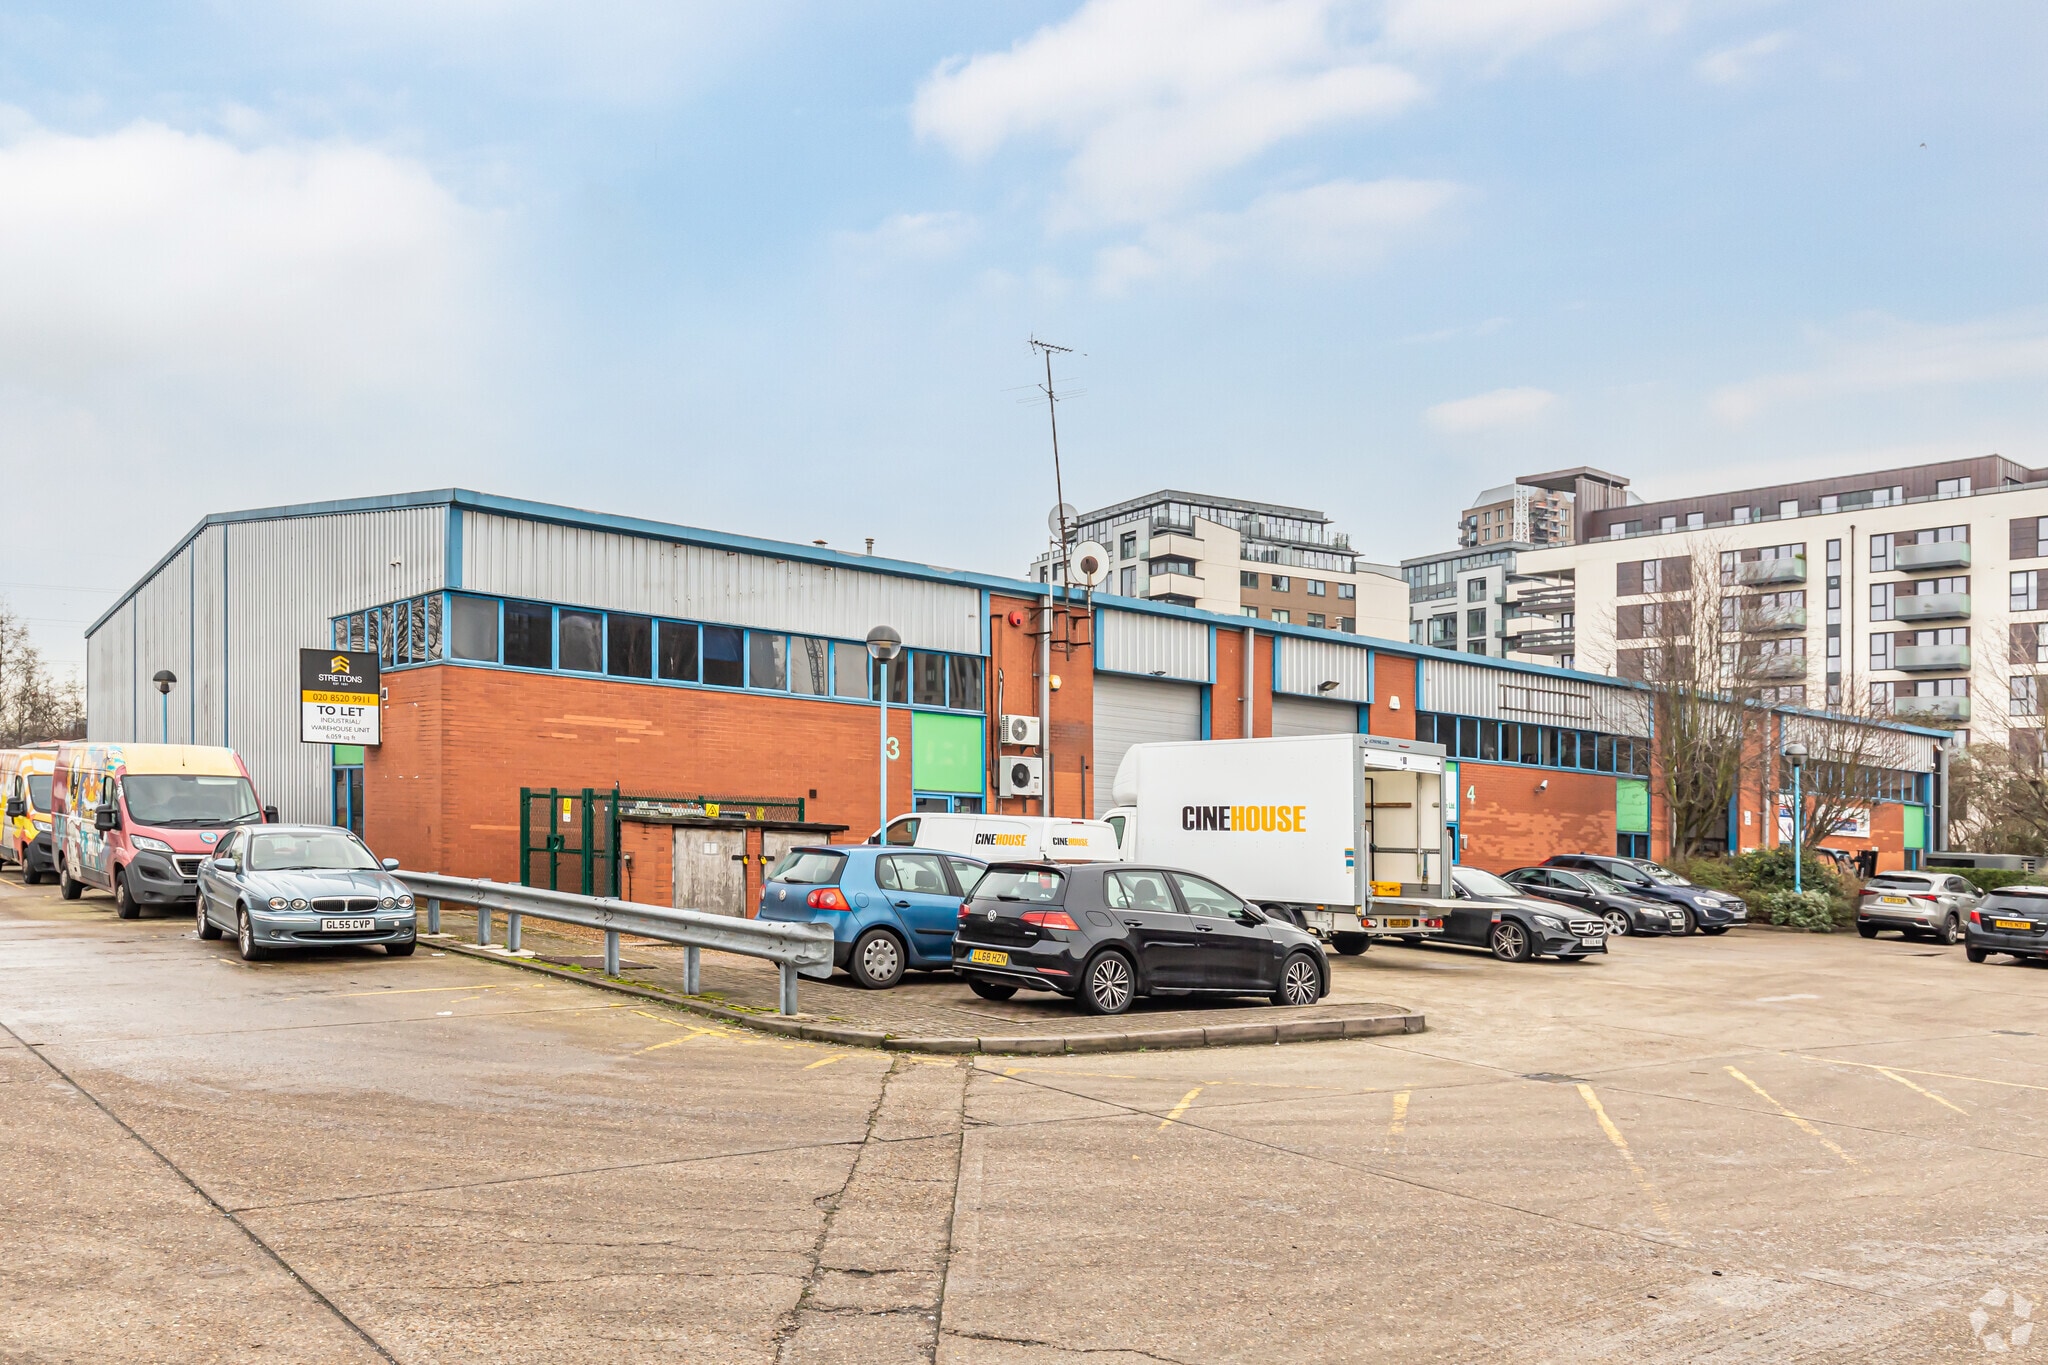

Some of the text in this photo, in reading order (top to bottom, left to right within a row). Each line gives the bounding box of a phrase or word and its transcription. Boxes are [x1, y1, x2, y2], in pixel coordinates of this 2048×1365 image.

[318, 673, 363, 683] STRETTONS
[312, 693, 328, 701] 020
[330, 694, 350, 702] 8520
[317, 705, 365, 716] TO LET
[320, 717, 361, 725] INDUSTRIAL/
[311, 724, 353, 732] WAREHOUSE
[886, 736, 900, 760] 3
[1466, 784, 1476, 804] 4
[1182, 805, 1307, 833] CINEHOUSE
[975, 833, 1028, 847] CINEHOUSE
[1052, 837, 1089, 847] CINEHOUSE
[326, 919, 371, 929] GL55 CVP
[973, 951, 1007, 964] LL68 HZN
